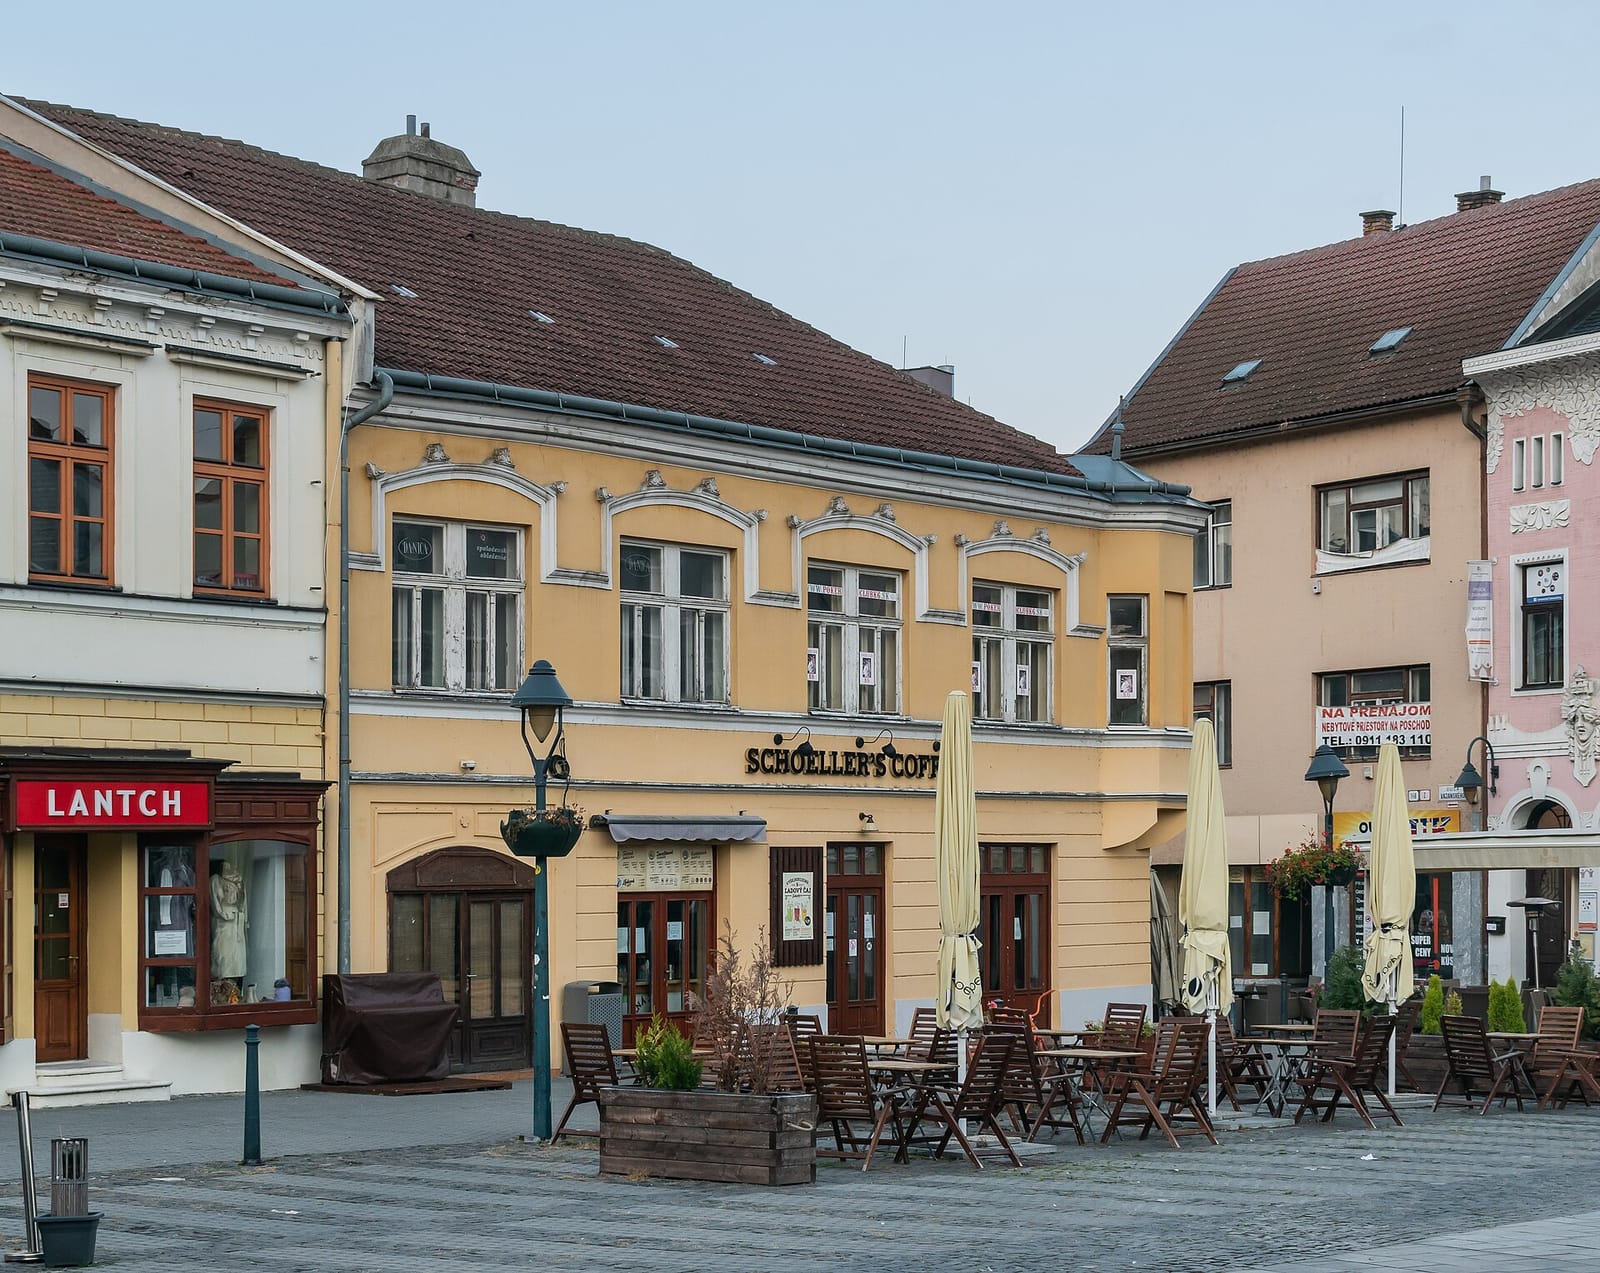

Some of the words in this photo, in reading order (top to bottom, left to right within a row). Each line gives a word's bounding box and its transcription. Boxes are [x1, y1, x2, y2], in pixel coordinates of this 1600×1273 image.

[1322, 708, 1344, 718] NA
[1356, 720, 1389, 732] PRIESTORY
[1389, 720, 1399, 731] NA
[1399, 719, 1431, 731] POSCHOD
[1355, 735, 1381, 745] 0911
[1410, 734, 1431, 745] 110
[890, 753, 938, 779] COFF
[48, 789, 181, 817] LANTCH
[1410, 935, 1431, 945] SUPER
[1415, 947, 1432, 957] CENY
[1440, 943, 1454, 954] NOV
[1440, 955, 1454, 966] KÚS
